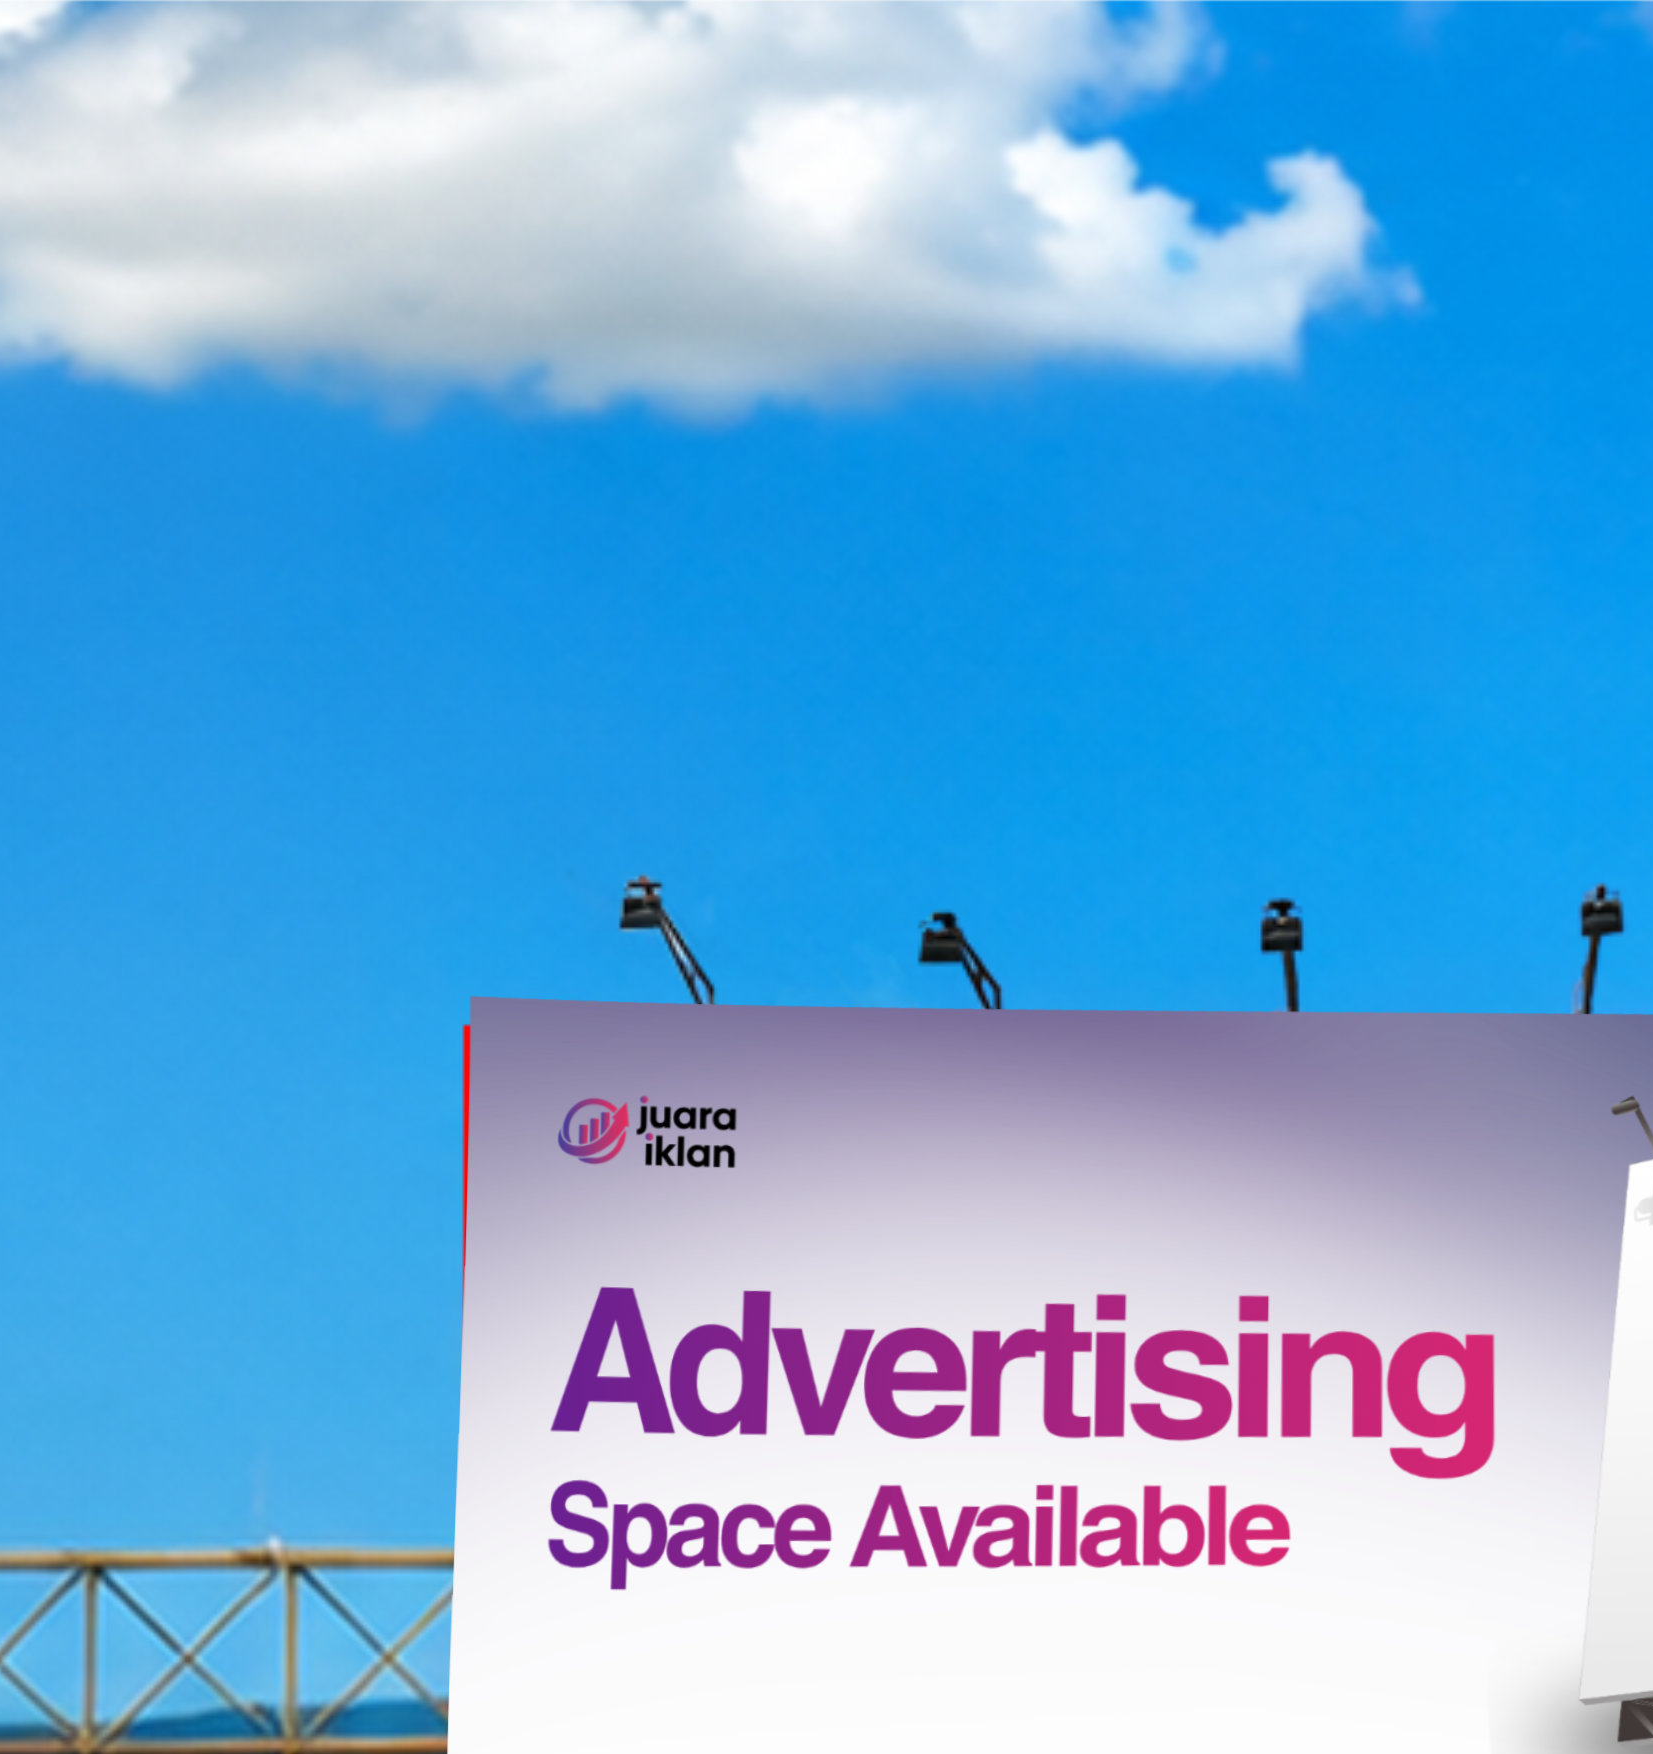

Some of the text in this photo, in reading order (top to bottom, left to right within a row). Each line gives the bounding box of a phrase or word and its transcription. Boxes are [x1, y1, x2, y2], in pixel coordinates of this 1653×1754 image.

[637, 1096, 737, 1134] juara
[644, 1133, 736, 1168] iklan
[551, 1286, 1496, 1479] Advertising
[548, 1480, 1291, 1590] Space Available
